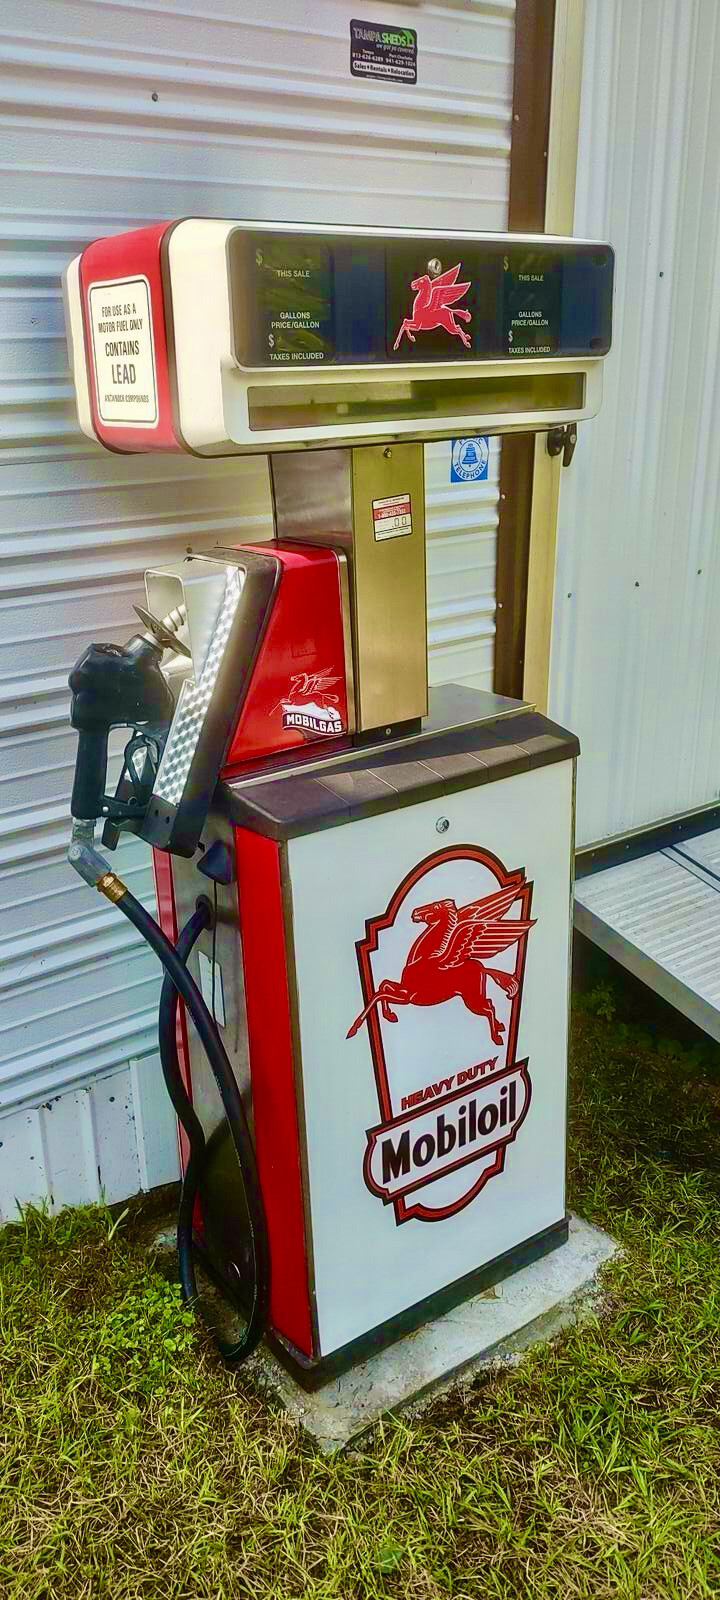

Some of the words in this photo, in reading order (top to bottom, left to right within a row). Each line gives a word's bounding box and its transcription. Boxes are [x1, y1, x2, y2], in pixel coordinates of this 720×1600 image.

[353, 27, 384, 42] TAMPA
[382, 32, 407, 47] SHEDS
[354, 62, 367, 70] Sales
[370, 65, 387, 73] Rentals
[391, 68, 415, 77] Relocation
[256, 248, 263, 266] $
[503, 255, 509, 272] $
[277, 270, 292, 278] THIS
[293, 270, 310, 278] SALE
[101, 306, 112, 318] FOR
[112, 304, 122, 317] USE
[123, 303, 132, 315] AS
[132, 302, 137, 315] A
[280, 312, 311, 320] GALLONS
[98, 321, 116, 333] MOTOR
[116, 319, 129, 332] FUEL
[129, 318, 143, 331] ONLY
[271, 321, 320, 329] PRICE/GALLON
[511, 319, 549, 327] PRICE/GALLON
[268, 333, 275, 348] $
[508, 329, 513, 343] $
[105, 340, 140, 357] CONTAINS
[269, 353, 291, 361] TAXES
[291, 352, 324, 360] INCLUDED
[111, 363, 137, 385] LEAD
[454, 460, 486, 479] TELEPHONE
[286, 713, 342, 733] MOBILGAS
[401, 1075, 455, 1111] HEAVY
[457, 1056, 499, 1086] DUTY
[381, 1080, 517, 1185] Mobiloil
